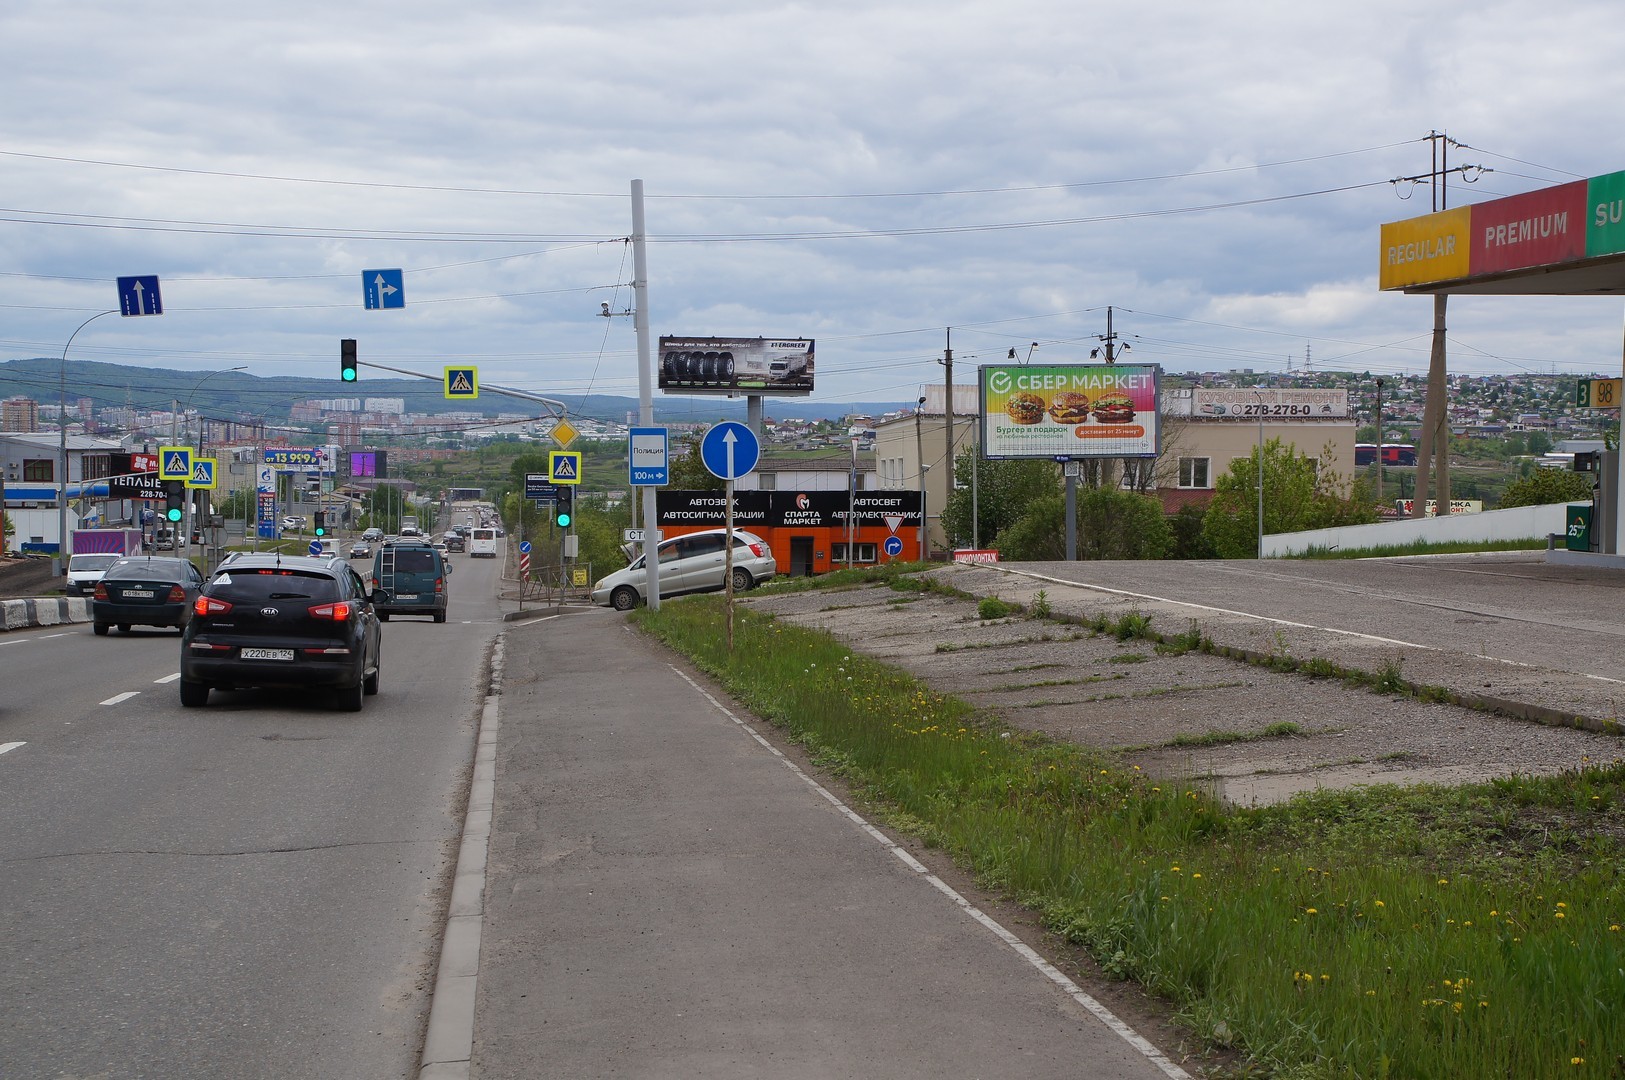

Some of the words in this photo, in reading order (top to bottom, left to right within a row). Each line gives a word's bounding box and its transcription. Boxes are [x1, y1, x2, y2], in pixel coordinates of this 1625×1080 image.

[1485, 211, 1568, 248] PREMIUM
[1387, 235, 1456, 266] REGULAR
[1017, 375, 1068, 390] СБЕР
[1072, 373, 1150, 390] МАРКЕТ
[1197, 390, 1278, 404] КУЗОВНОЙ
[1281, 391, 1344, 404] РЕМОНТ
[1579, 384, 1588, 405] 3
[1598, 382, 1613, 404] 98
[1244, 404, 1311, 416] 278-278-0
[996, 426, 1025, 435] Бургер
[1034, 427, 1068, 435] подарок
[633, 447, 664, 455] Полиция
[275, 453, 287, 463] 13
[634, 471, 647, 480] 100
[689, 498, 740, 506] АВТОЗВК
[853, 498, 902, 506] АВТОСВЕТ
[663, 511, 765, 520] АВТОСИГНАЛЗАЦИИ
[279, 649, 293, 657] 124
